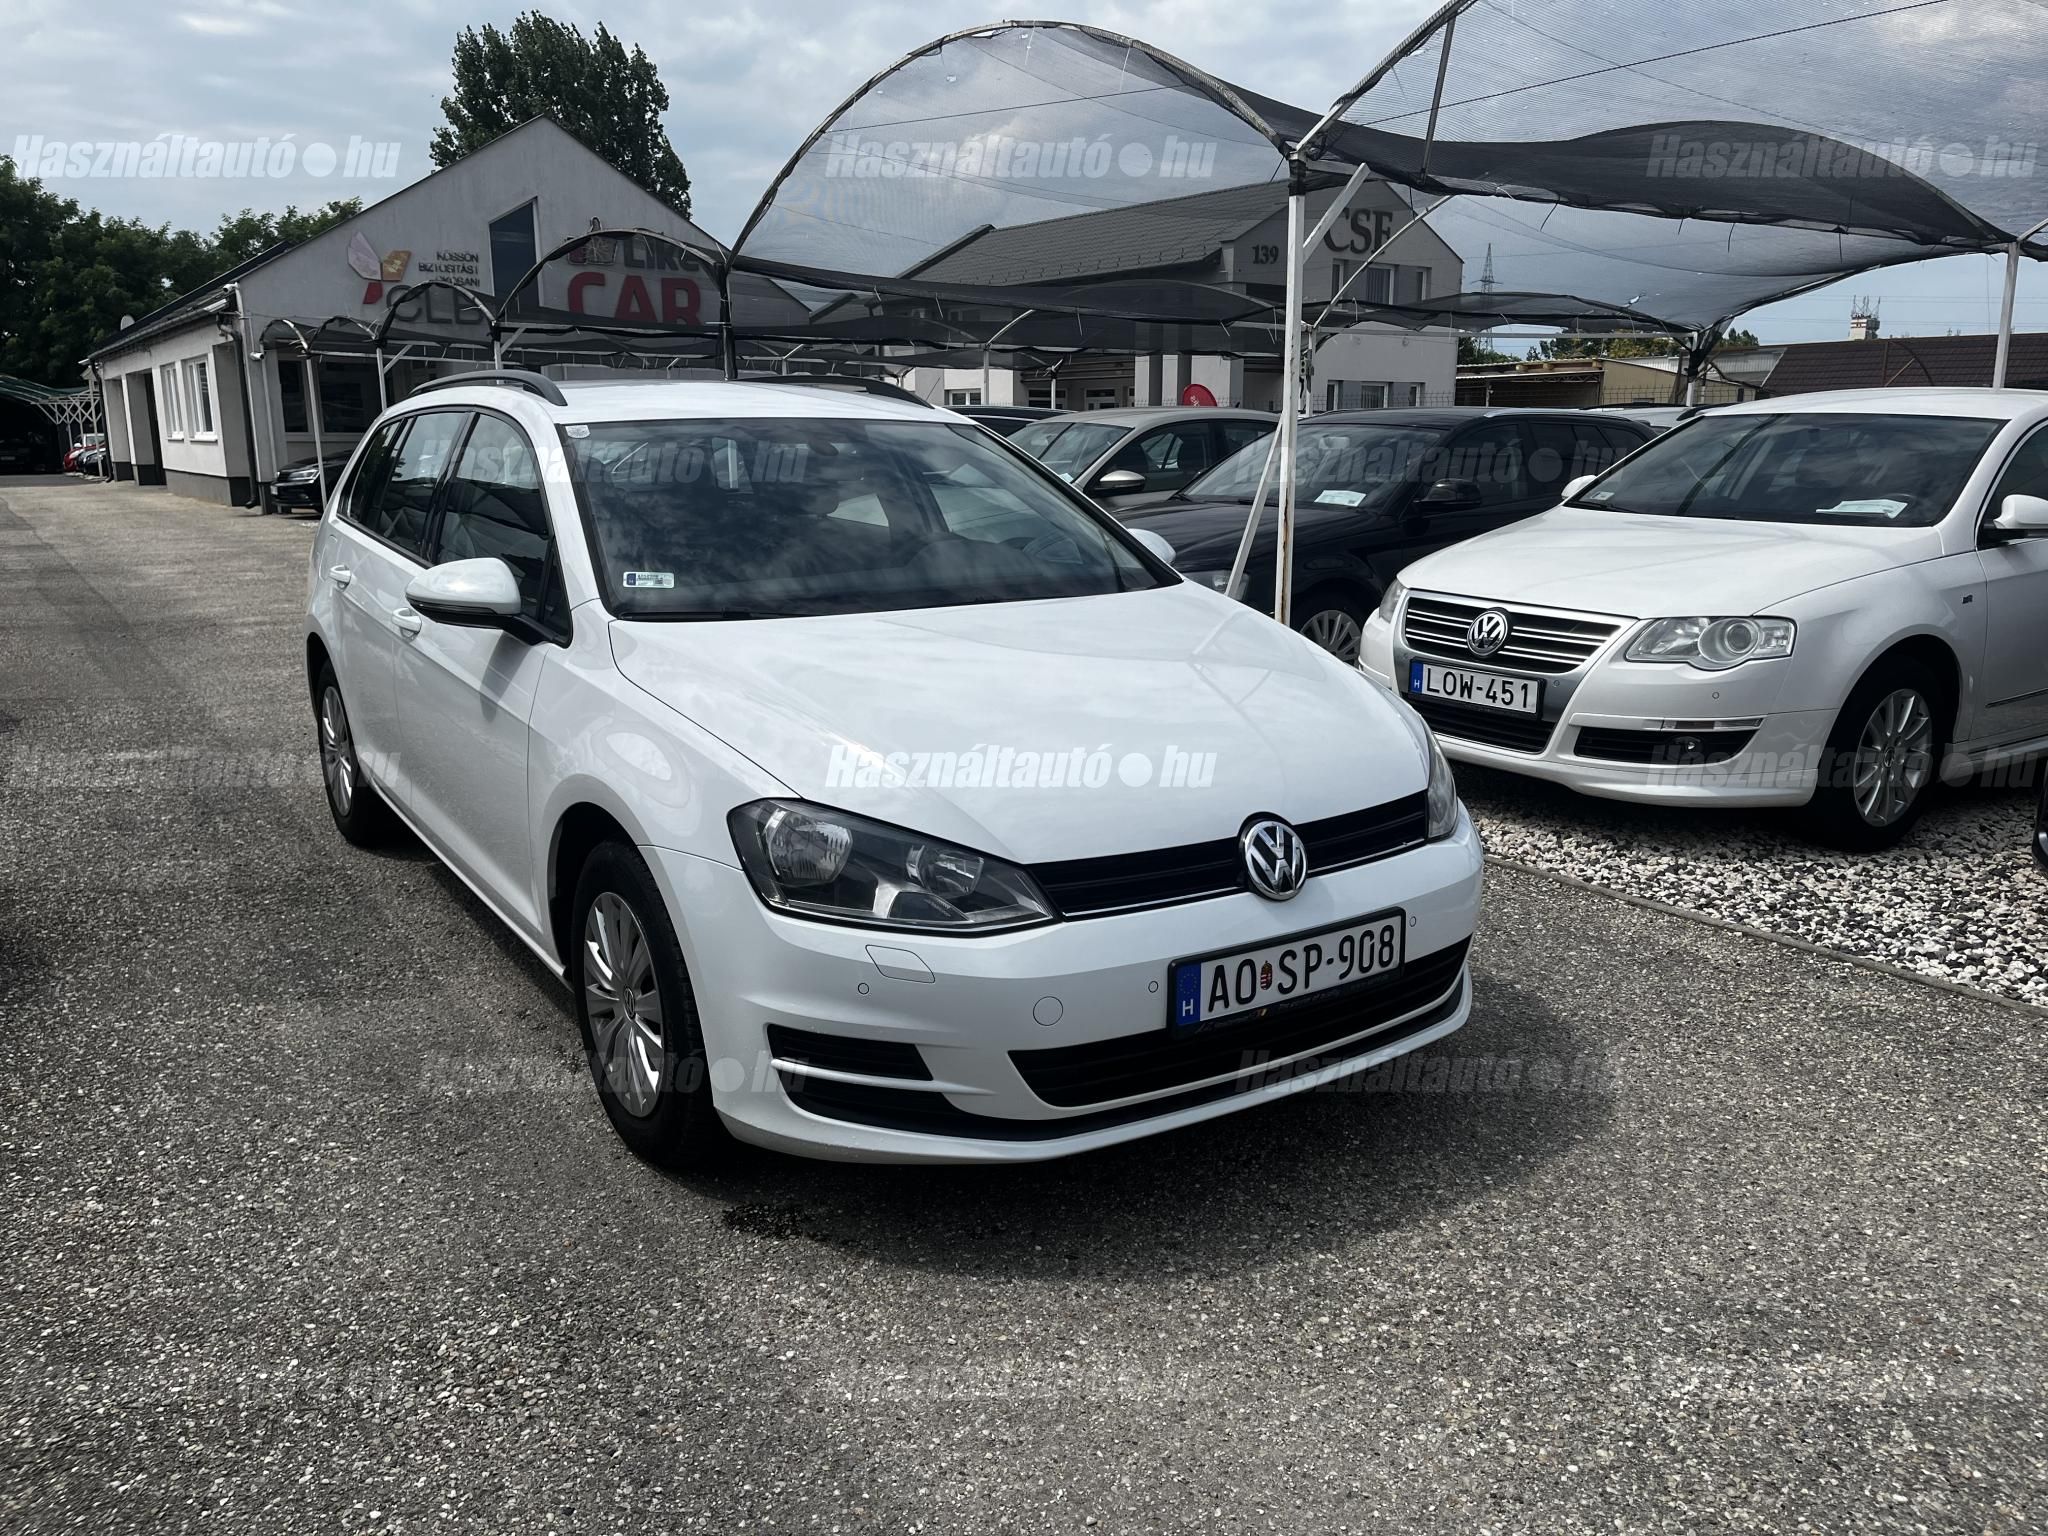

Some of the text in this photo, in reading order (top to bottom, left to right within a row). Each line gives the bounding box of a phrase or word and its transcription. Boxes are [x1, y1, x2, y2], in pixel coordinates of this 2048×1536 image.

[1251, 245, 1279, 264] 139
[568, 272, 703, 326] CAR
[1427, 668, 1528, 709] LOW-451
[1182, 999, 1194, 1016] H
